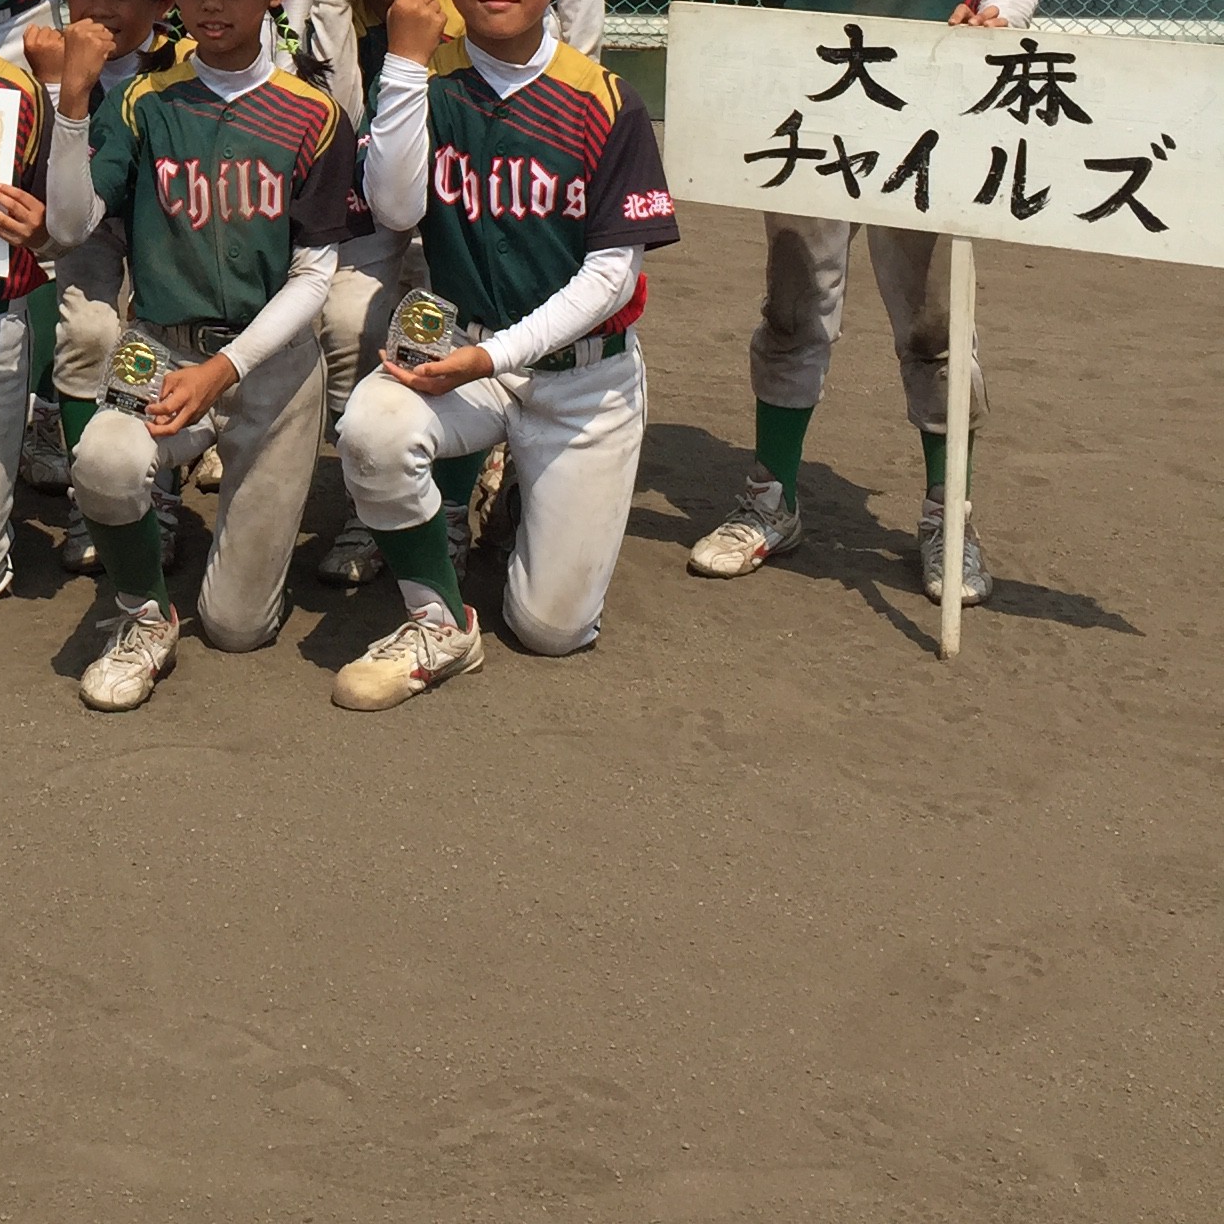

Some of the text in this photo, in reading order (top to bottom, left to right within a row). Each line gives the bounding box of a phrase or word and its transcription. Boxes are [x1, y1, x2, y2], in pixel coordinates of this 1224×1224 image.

[433, 144, 587, 221] Childs
[742, 109, 1178, 234] チャイルズ
